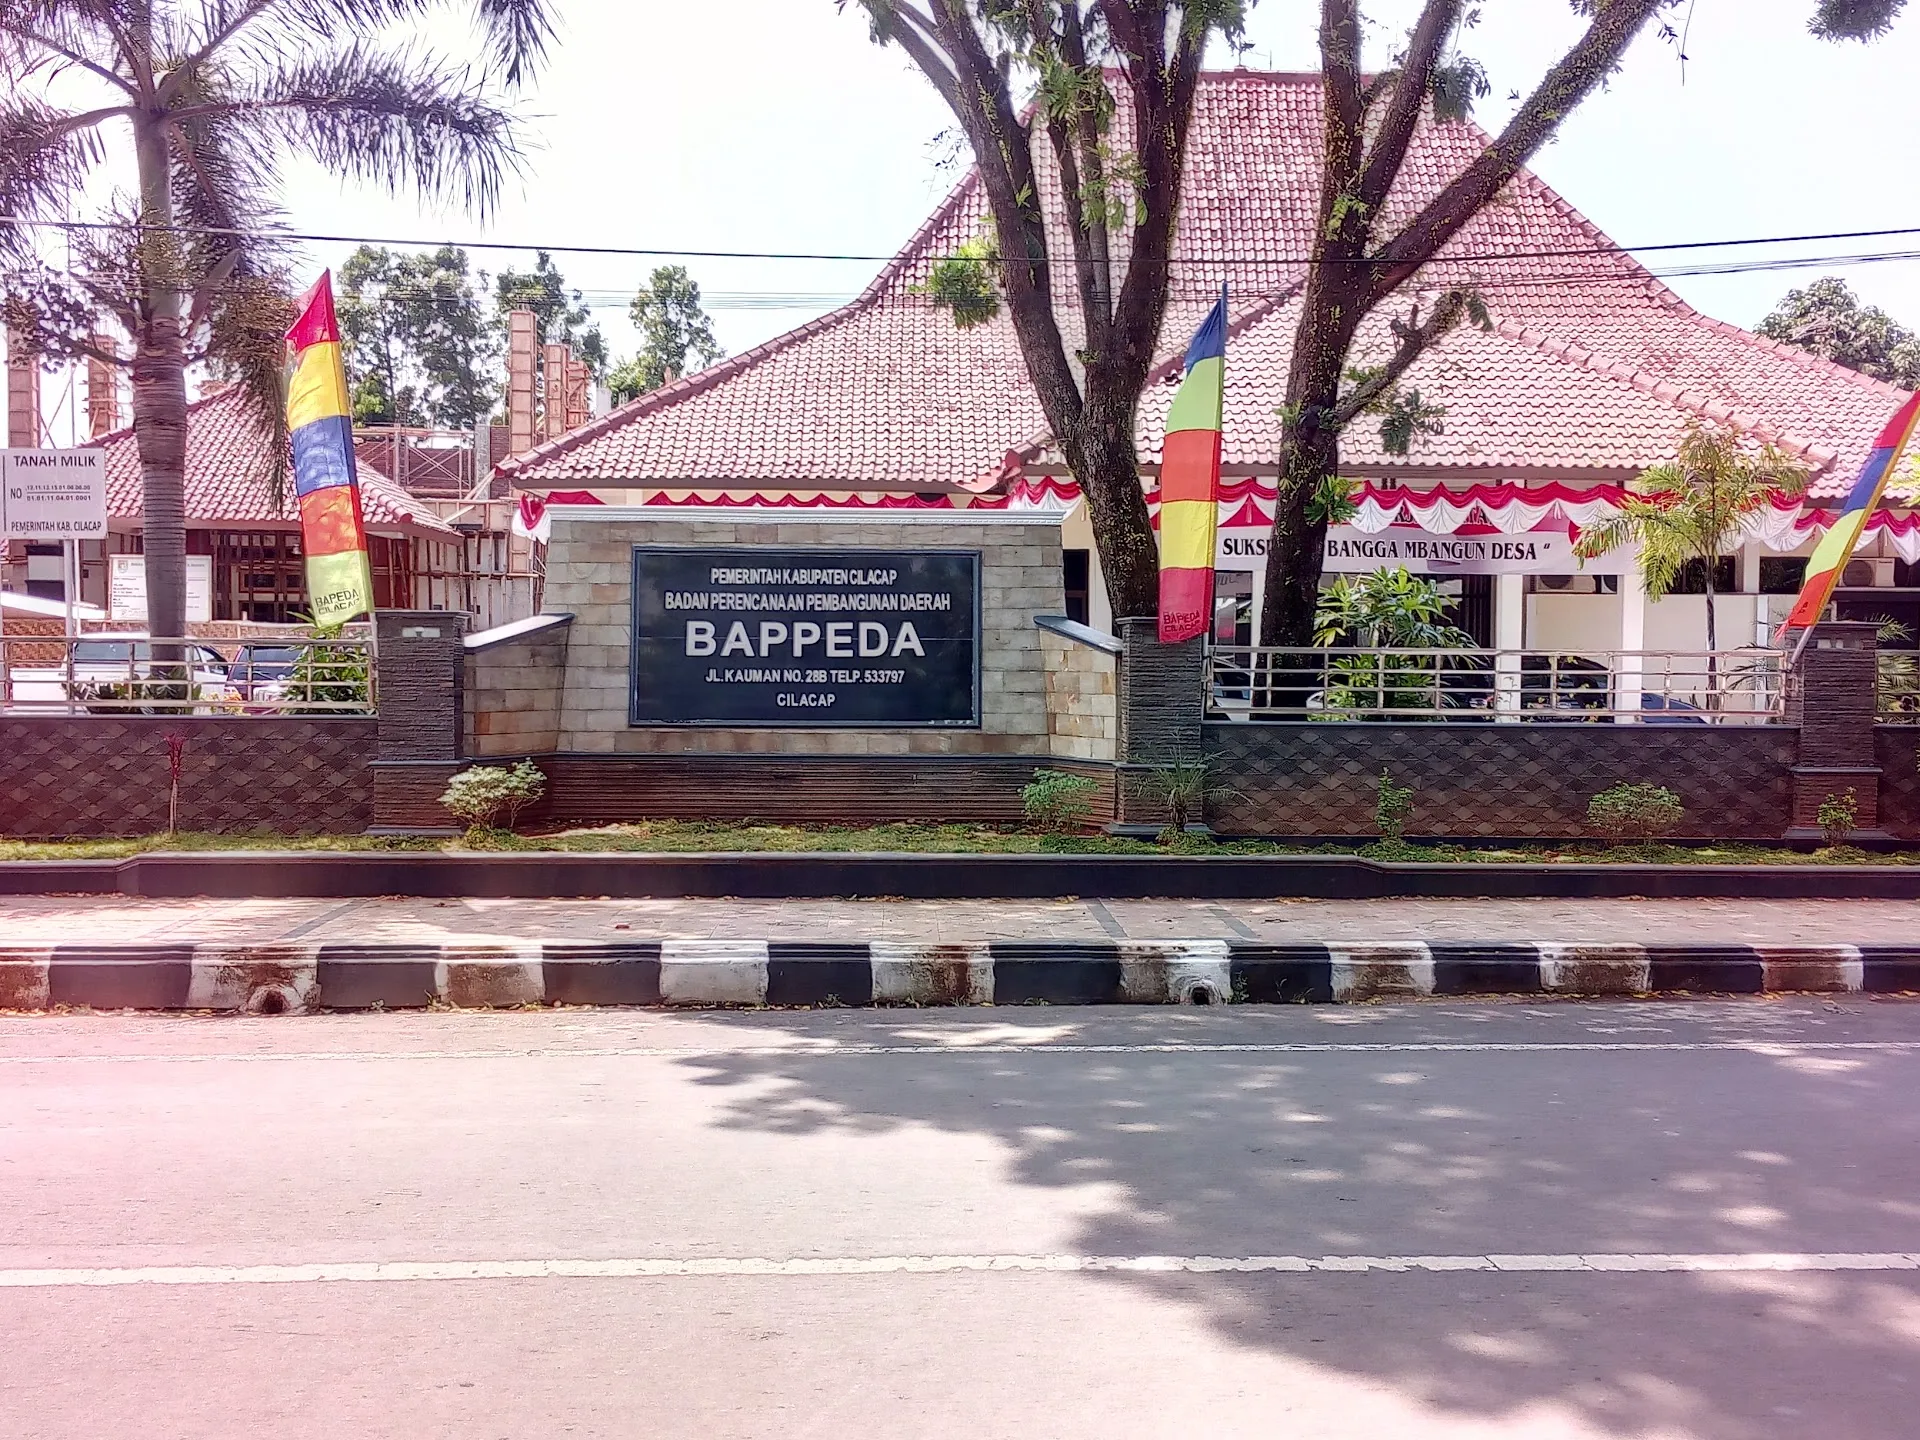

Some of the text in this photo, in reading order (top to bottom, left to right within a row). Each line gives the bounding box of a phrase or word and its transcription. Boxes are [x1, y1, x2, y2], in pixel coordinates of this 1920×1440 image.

[13, 455, 96, 467] TANAH MILIK
[10, 487, 23, 500] NO
[11, 521, 102, 532] PEMERINTAH KAB. CILACAP
[1222, 538, 1272, 556] SUKS
[1327, 539, 1399, 559] BANGGA
[1404, 541, 1486, 561] MBANGUN
[1490, 542, 1537, 561] DESA
[709, 567, 898, 586] PEMERINTAH KABUPATEN CILACAP
[315, 588, 360, 608] BAPEDA
[664, 591, 951, 611] BADAN PERENCANAAN PEMBANGUNAN DAERAH
[685, 620, 926, 658] BAPPEDA
[724, 669, 781, 683] KAUMAN
[783, 670, 804, 683] NO.
[805, 670, 828, 684] 28B
[829, 670, 863, 684] TELP.
[864, 670, 905, 684] 533797
[776, 693, 836, 708] CILACAP
